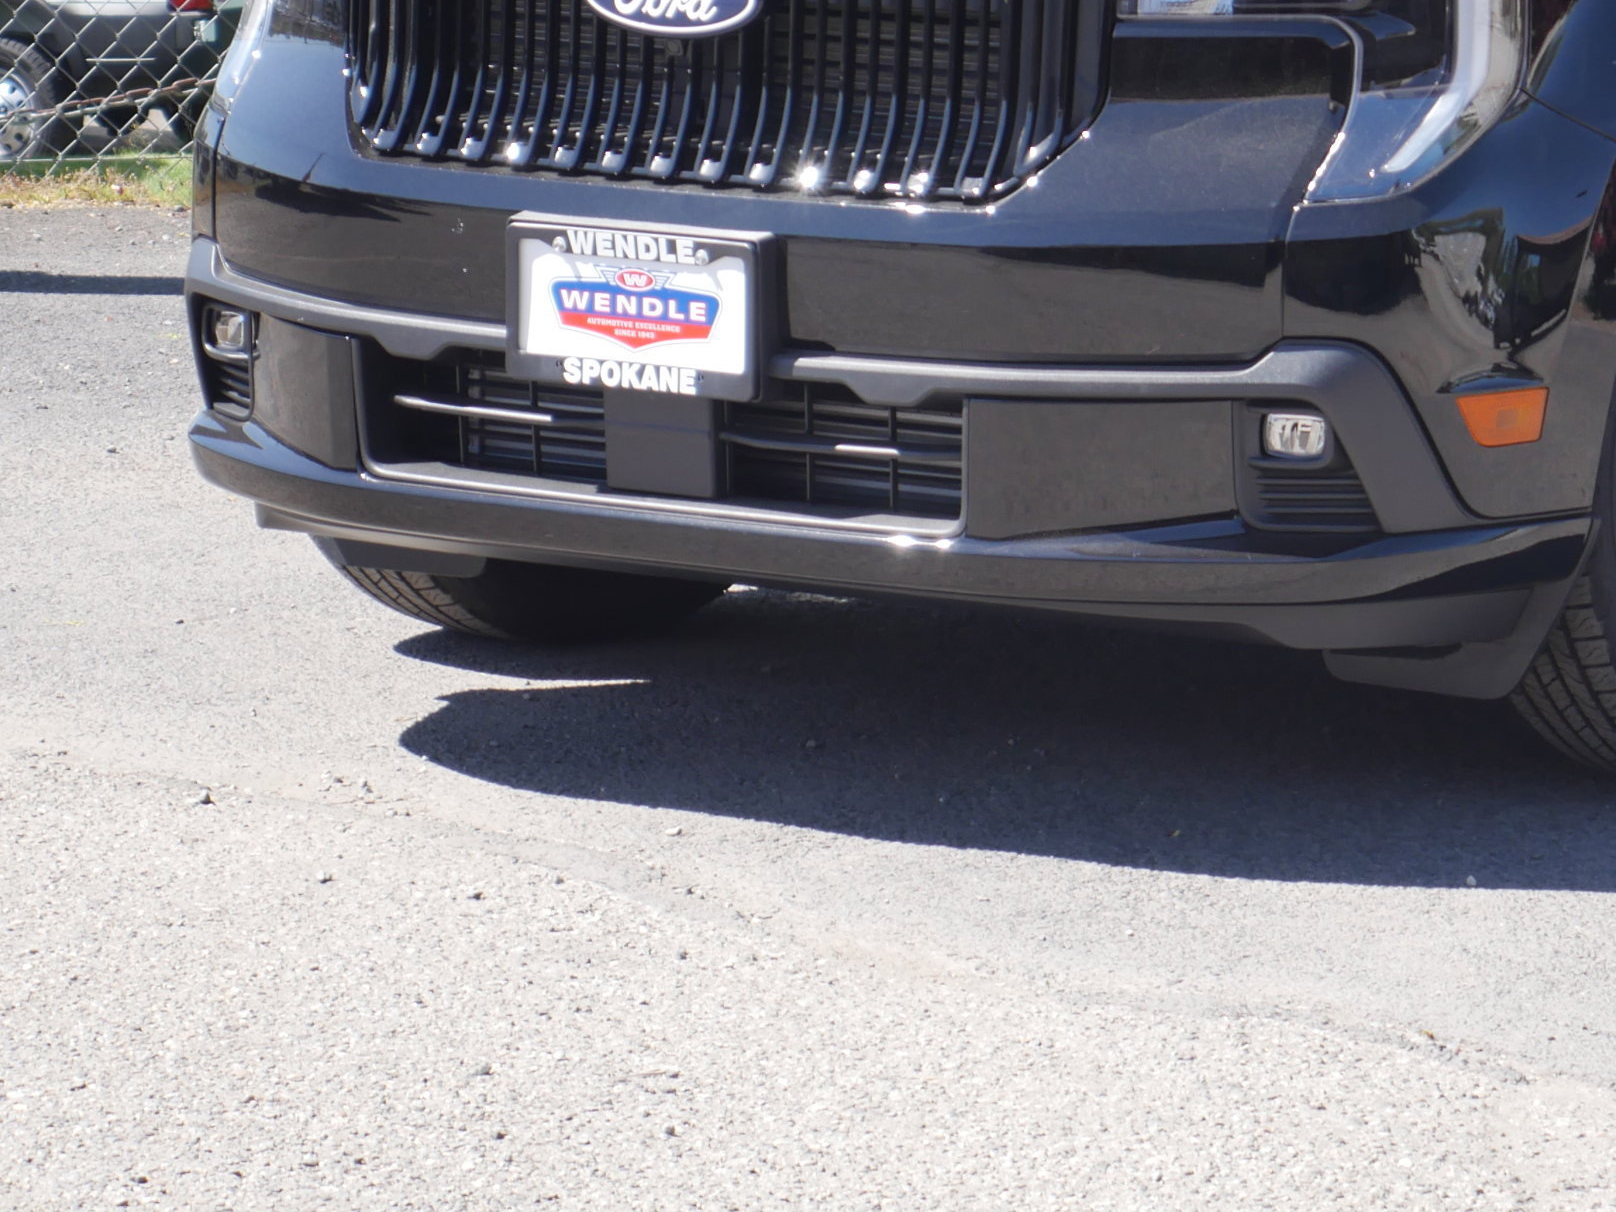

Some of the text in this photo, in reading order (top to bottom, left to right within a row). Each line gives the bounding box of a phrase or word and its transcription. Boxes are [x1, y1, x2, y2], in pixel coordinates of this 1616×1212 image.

[567, 229, 696, 265] WENDLE
[560, 288, 707, 322] WENDLE
[586, 316, 681, 333] AUTOMOTIVE EXCELLENCE
[614, 328, 637, 337] SINCE
[562, 356, 697, 396] SPOKANE
